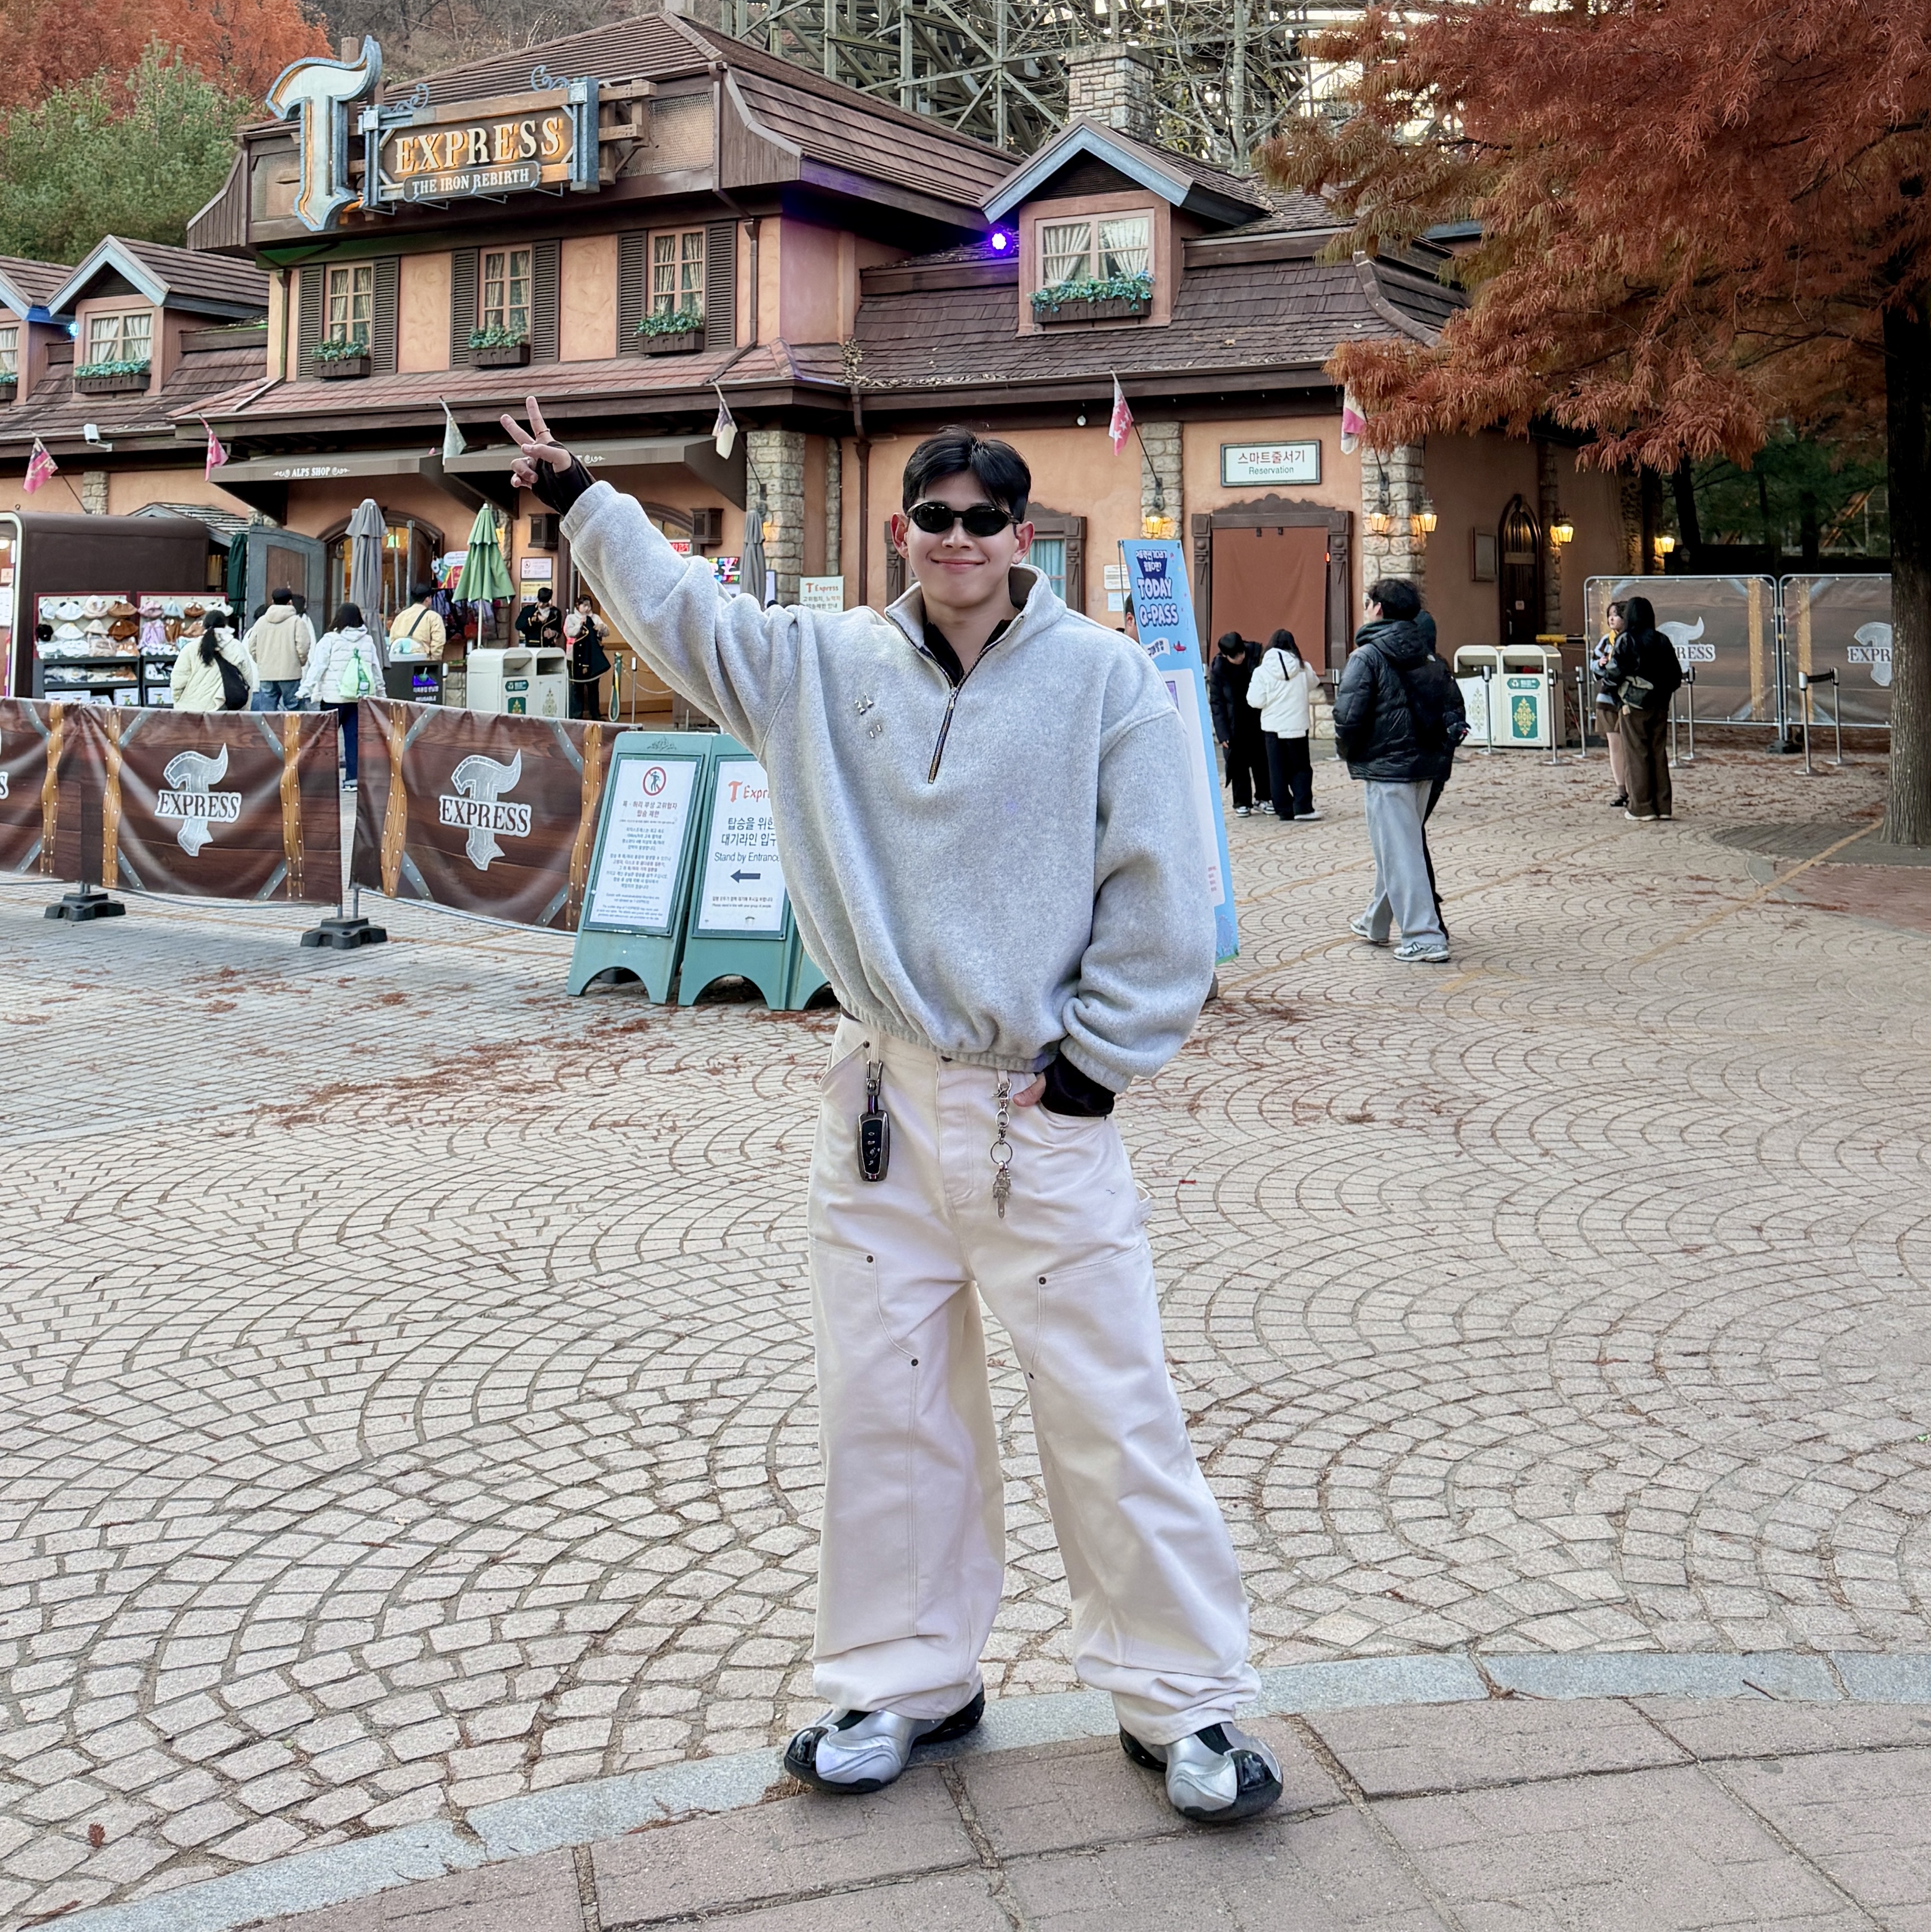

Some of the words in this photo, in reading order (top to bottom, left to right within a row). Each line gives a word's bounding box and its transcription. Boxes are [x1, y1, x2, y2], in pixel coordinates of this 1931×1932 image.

[266, 35, 383, 231] T
[395, 117, 562, 173] EXPRESS
[412, 176, 437, 194] THE
[440, 173, 470, 191] IRON
[472, 167, 529, 188] REBIRTH
[1238, 450, 1305, 464] 스마트줄서기
[292, 468, 309, 477] ALPS
[311, 466, 331, 476] SHOP
[1249, 465, 1294, 474] Reservation
[805, 582, 814, 593] T
[815, 584, 839, 593] Express
[1137, 577, 1173, 600] TODAY
[1139, 603, 1179, 627] Q-PASS
[1677, 646, 1713, 659] RESS
[1849, 647, 1892, 662] EXPR
[728, 780, 743, 803] T
[743, 785, 769, 803] Expr
[158, 792, 240, 819] EXPRESS
[441, 798, 528, 832] EXPRESS
[728, 817, 755, 830] 탑승을
[721, 833, 757, 846] 대기라인
[761, 833, 777, 846] 입구
[714, 852, 736, 862] Stand
[737, 852, 746, 864] by
